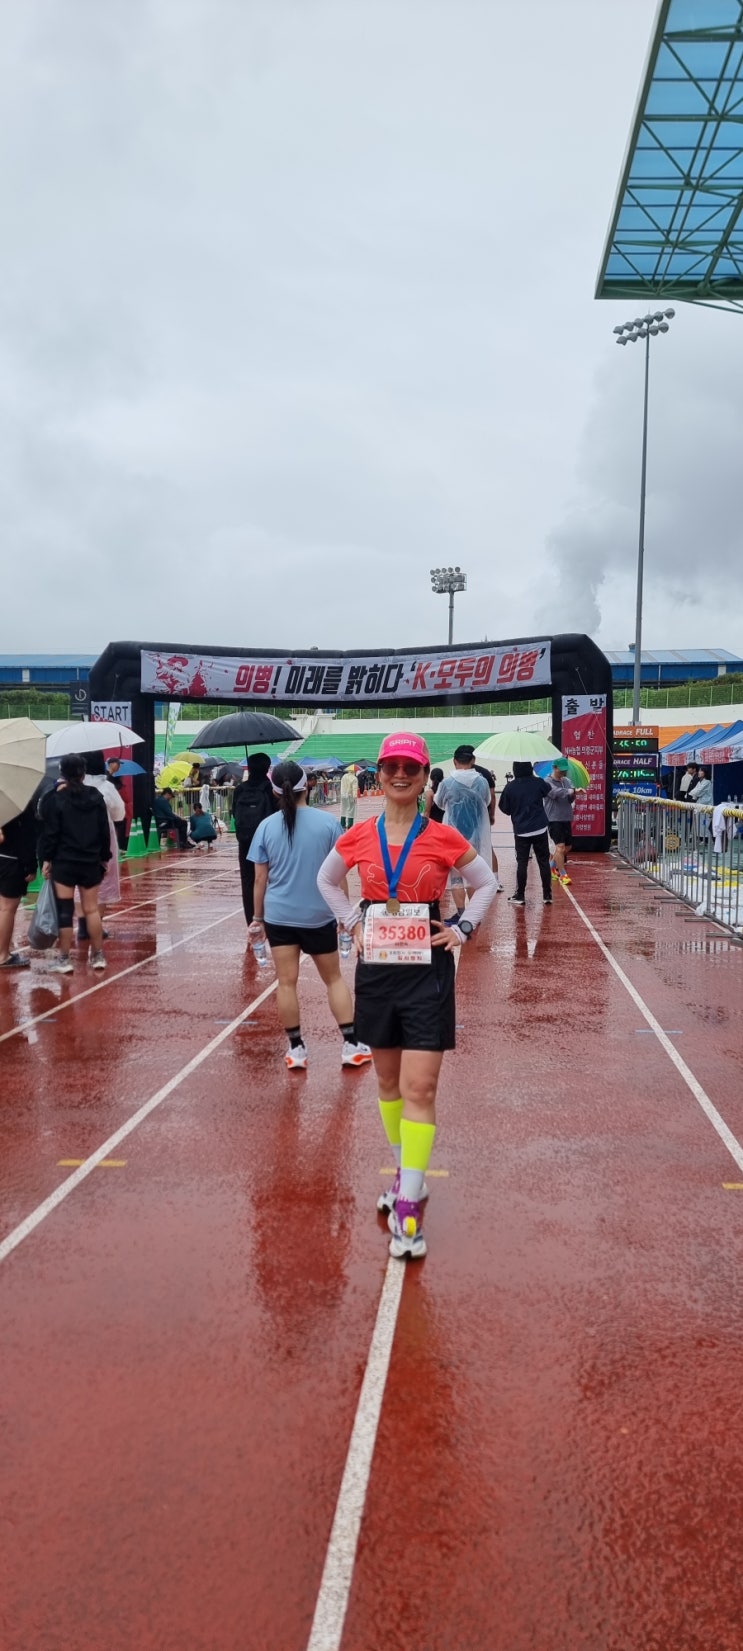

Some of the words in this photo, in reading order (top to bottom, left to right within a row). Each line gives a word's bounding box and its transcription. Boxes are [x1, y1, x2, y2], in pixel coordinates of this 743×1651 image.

[284, 665, 344, 695] 미래를
[344, 663, 404, 695] 밝히다
[93, 705, 129, 722] START
[635, 728, 653, 736] FULL
[389, 739, 418, 747] GRIPIT
[633, 757, 653, 765] HALF
[632, 786, 653, 794] 10km
[379, 925, 427, 941] 35380
